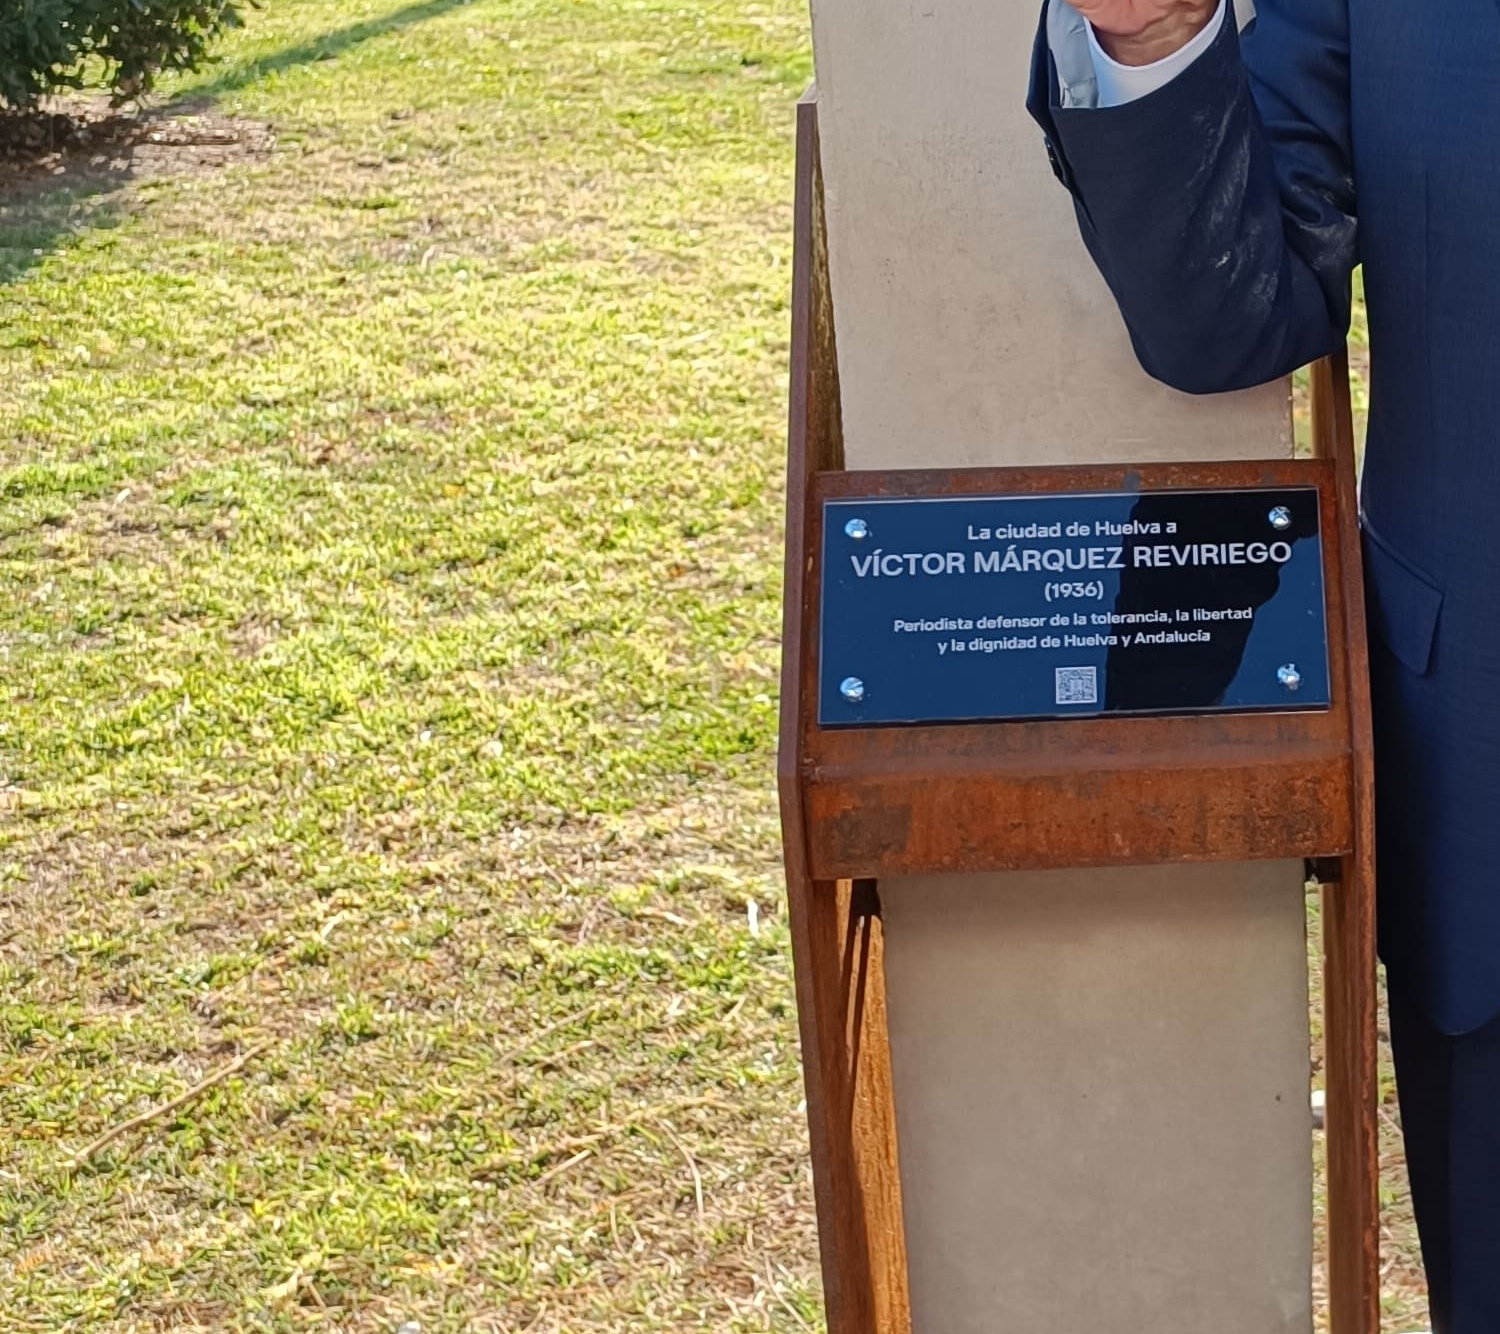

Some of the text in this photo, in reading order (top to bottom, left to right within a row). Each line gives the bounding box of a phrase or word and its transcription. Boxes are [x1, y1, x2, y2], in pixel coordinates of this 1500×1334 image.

[967, 520, 1177, 541] La ciudad de Huelva a
[851, 541, 1292, 577] VÍCTOR MÁRQUEZ REVIRIEGO
[1045, 580, 1104, 602] (1936)
[894, 606, 1253, 632] Periodista defensor de la tolerancia, la libertad
[938, 629, 1211, 655] y la dignidad de Huelva y Andalucía
